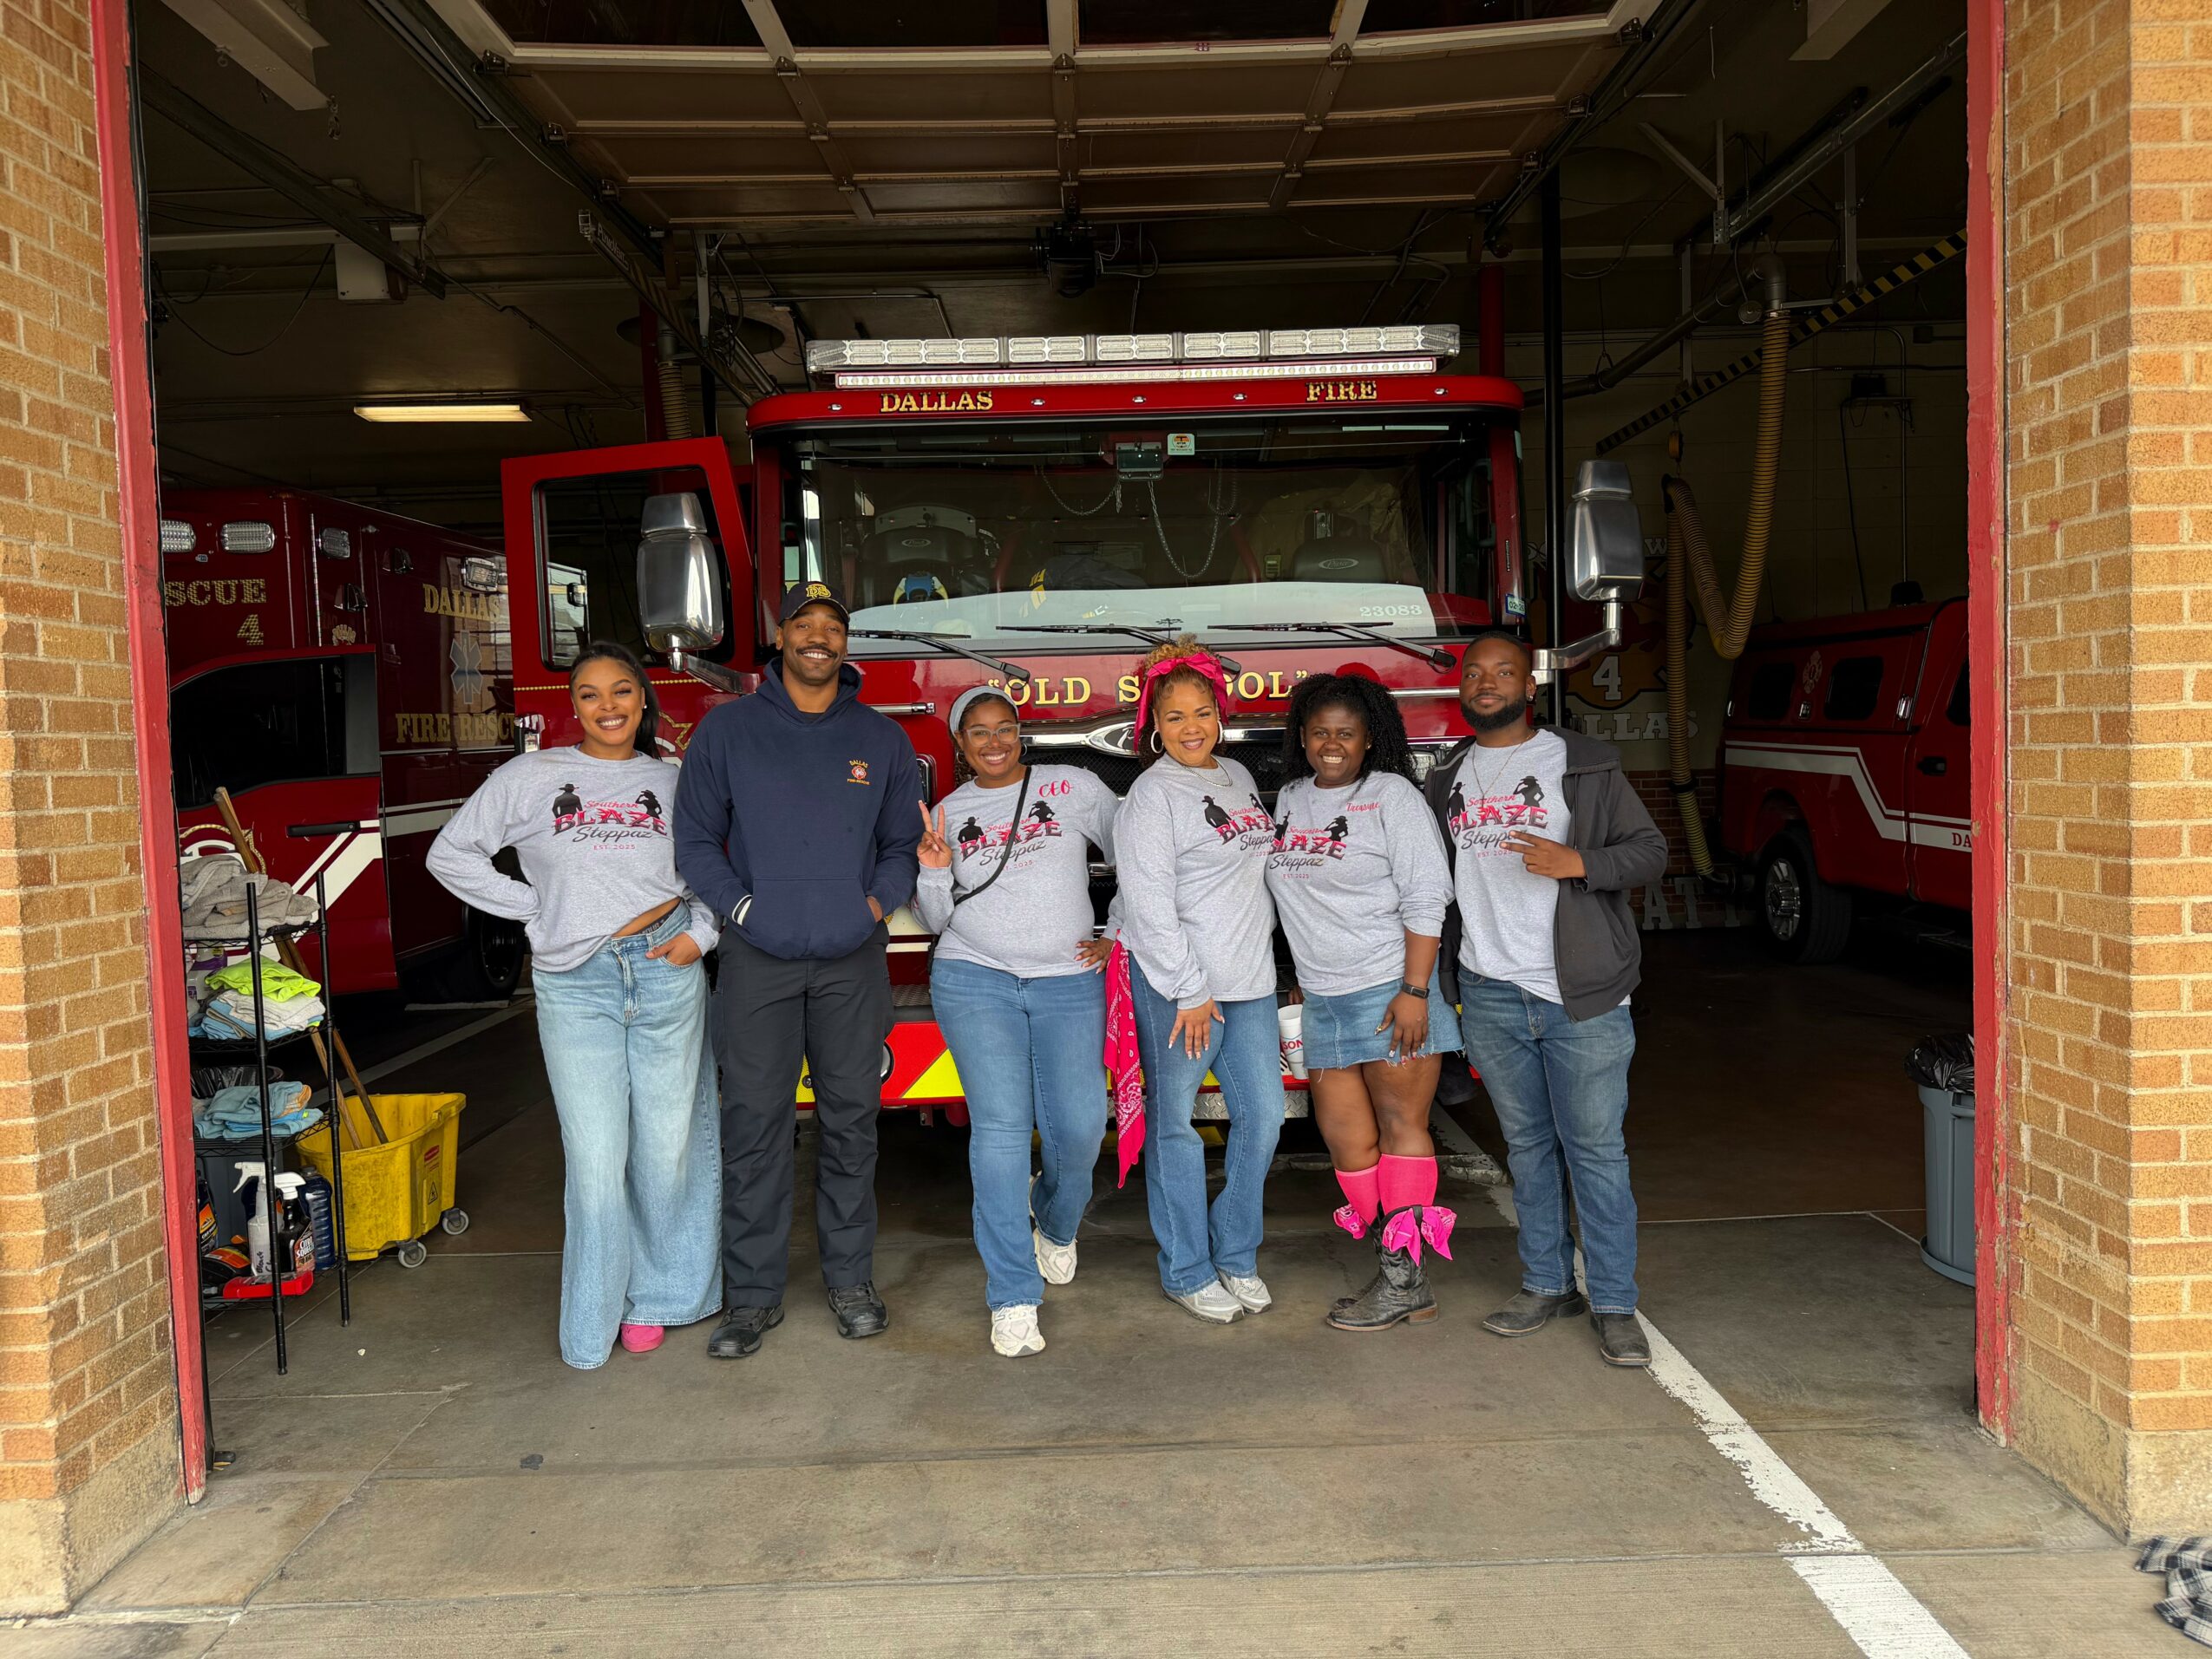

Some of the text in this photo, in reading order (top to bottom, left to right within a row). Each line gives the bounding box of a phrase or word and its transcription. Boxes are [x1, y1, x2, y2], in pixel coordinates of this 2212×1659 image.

[880, 381, 1378, 413] DALLAS FIRE
[422, 584, 501, 624] DALLAS
[1359, 604, 1423, 617] 23083
[237, 614, 264, 645] 4
[1592, 655, 1623, 701] 4
[396, 713, 451, 743] FIRE
[848, 759, 868, 768] DALLAS
[1038, 780, 1073, 798] CEO
[584, 800, 640, 809] Southern
[552, 807, 668, 837] BLAZE
[572, 826, 653, 843] Steppaz
[1269, 853, 1325, 872] Steppaz
